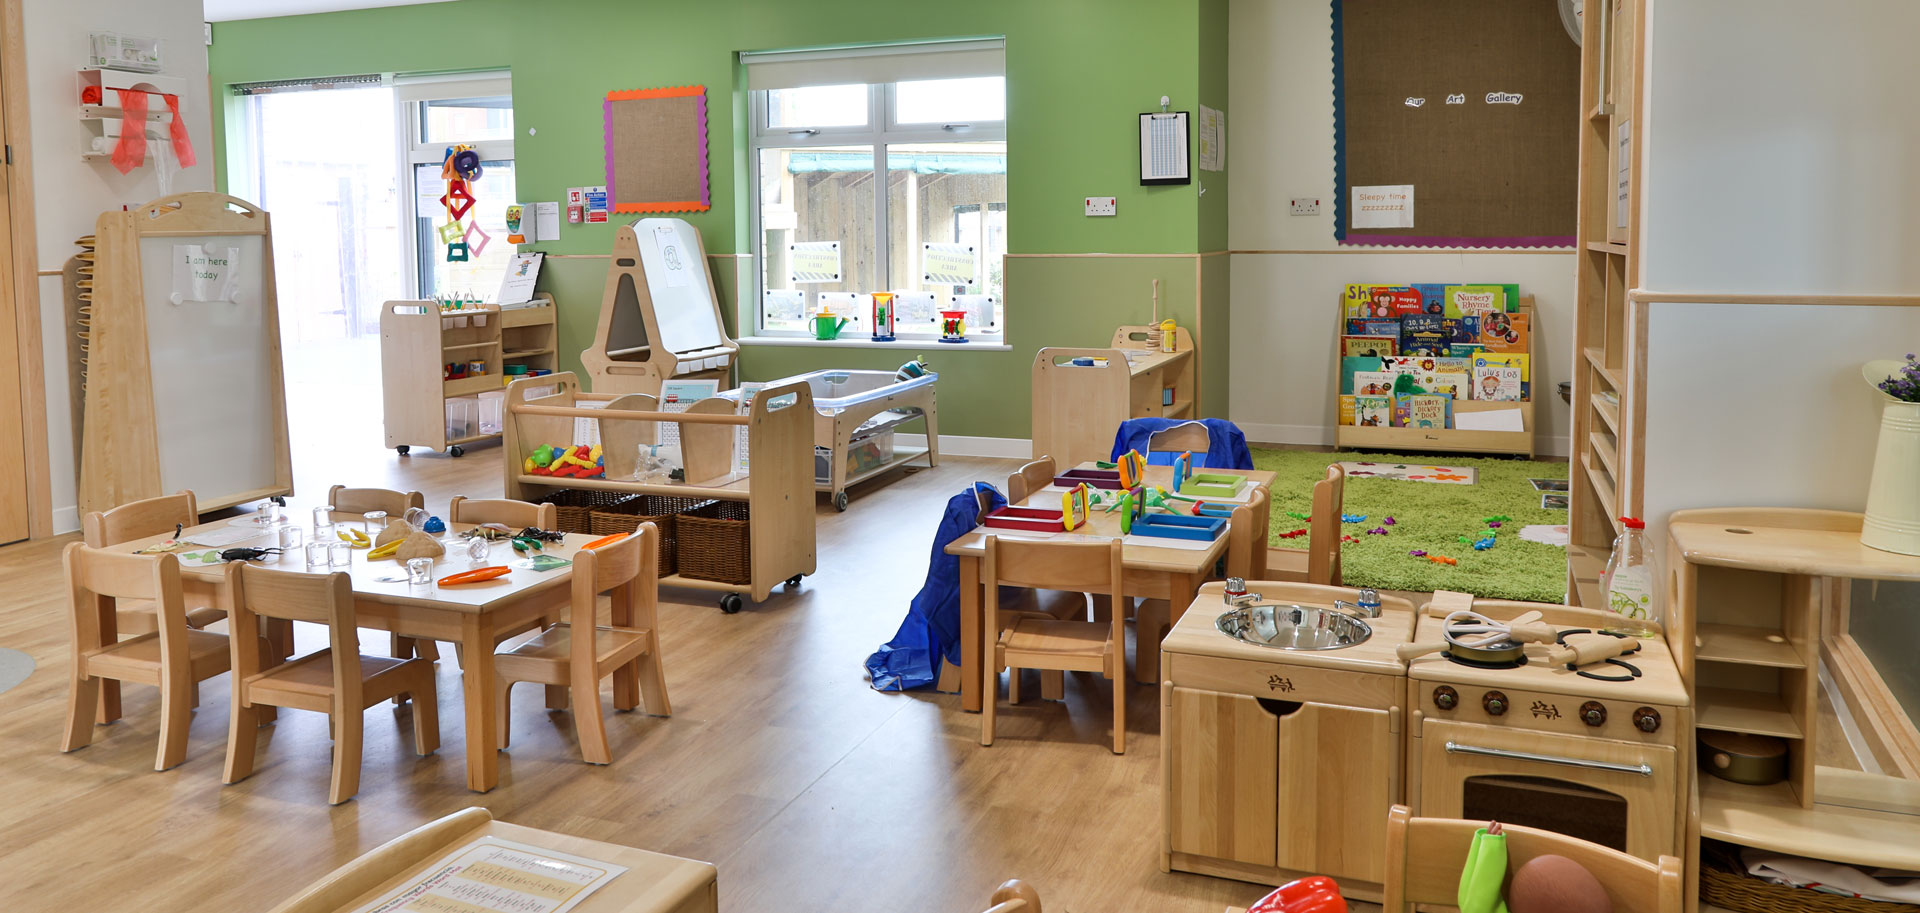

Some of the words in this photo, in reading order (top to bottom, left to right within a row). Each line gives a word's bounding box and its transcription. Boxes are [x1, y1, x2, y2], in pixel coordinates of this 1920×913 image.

[1447, 94, 1463, 103] Art
[1487, 93, 1522, 104] Gallery
[1359, 193, 1386, 201] Sleepy
[186, 255, 190, 264] I
[193, 257, 206, 265] am
[208, 257, 228, 266] here
[195, 269, 218, 281] today
[1348, 286, 1367, 300] Sh
[1458, 294, 1490, 302] Nursery
[1462, 301, 1489, 309] Rhyme
[1478, 369, 1500, 377] Lulu's
